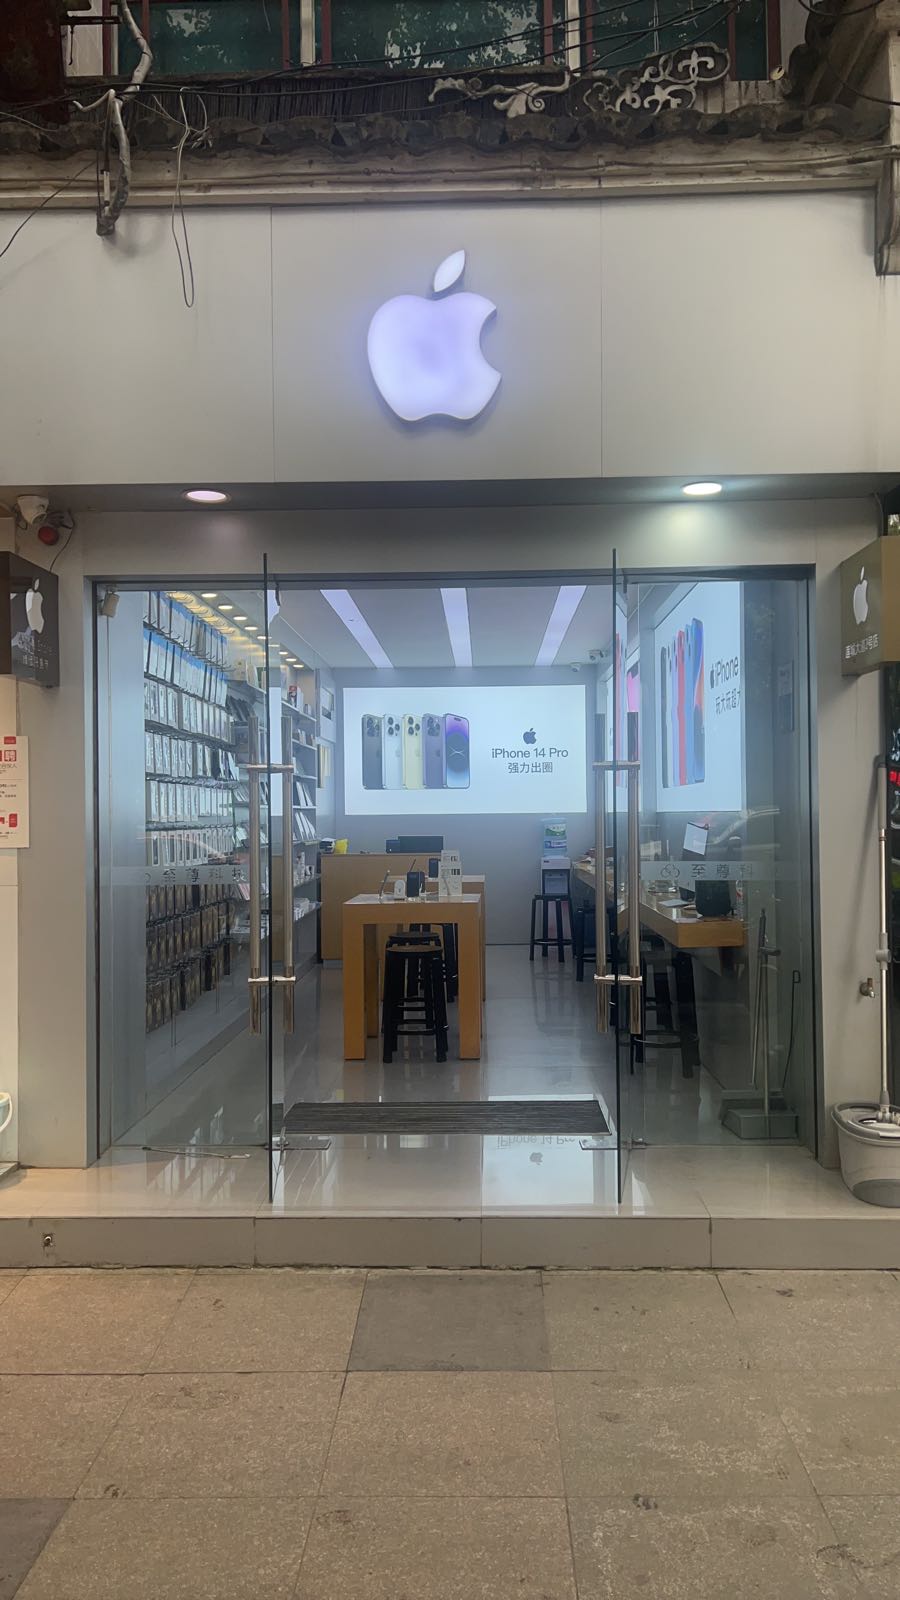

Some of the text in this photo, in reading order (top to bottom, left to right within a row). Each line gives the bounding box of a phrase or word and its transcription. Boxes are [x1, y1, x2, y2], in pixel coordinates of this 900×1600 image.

[714, 656, 739, 687] iPhone
[491, 747, 569, 759] iPhone 14 Pro
[508, 762, 553, 774] 强力出圈
